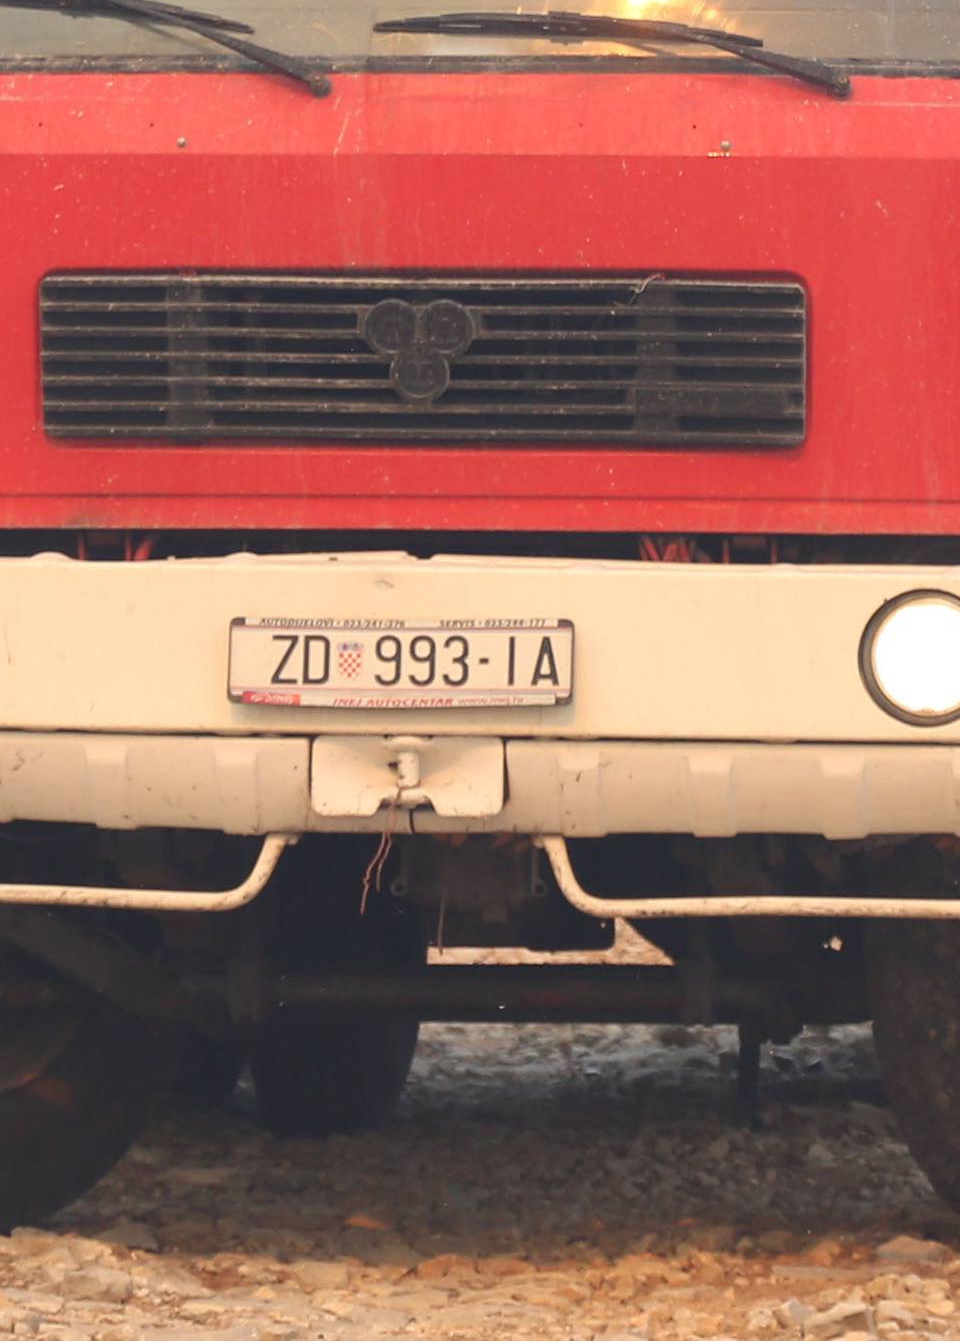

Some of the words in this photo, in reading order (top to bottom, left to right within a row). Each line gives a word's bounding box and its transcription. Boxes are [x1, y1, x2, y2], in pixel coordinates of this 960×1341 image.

[439, 619, 475, 628] SERVIS
[270, 634, 331, 685] ZD
[374, 634, 560, 687] 993-IA
[332, 698, 362, 707] INEJ
[367, 698, 454, 708] AUTOCENTAR
